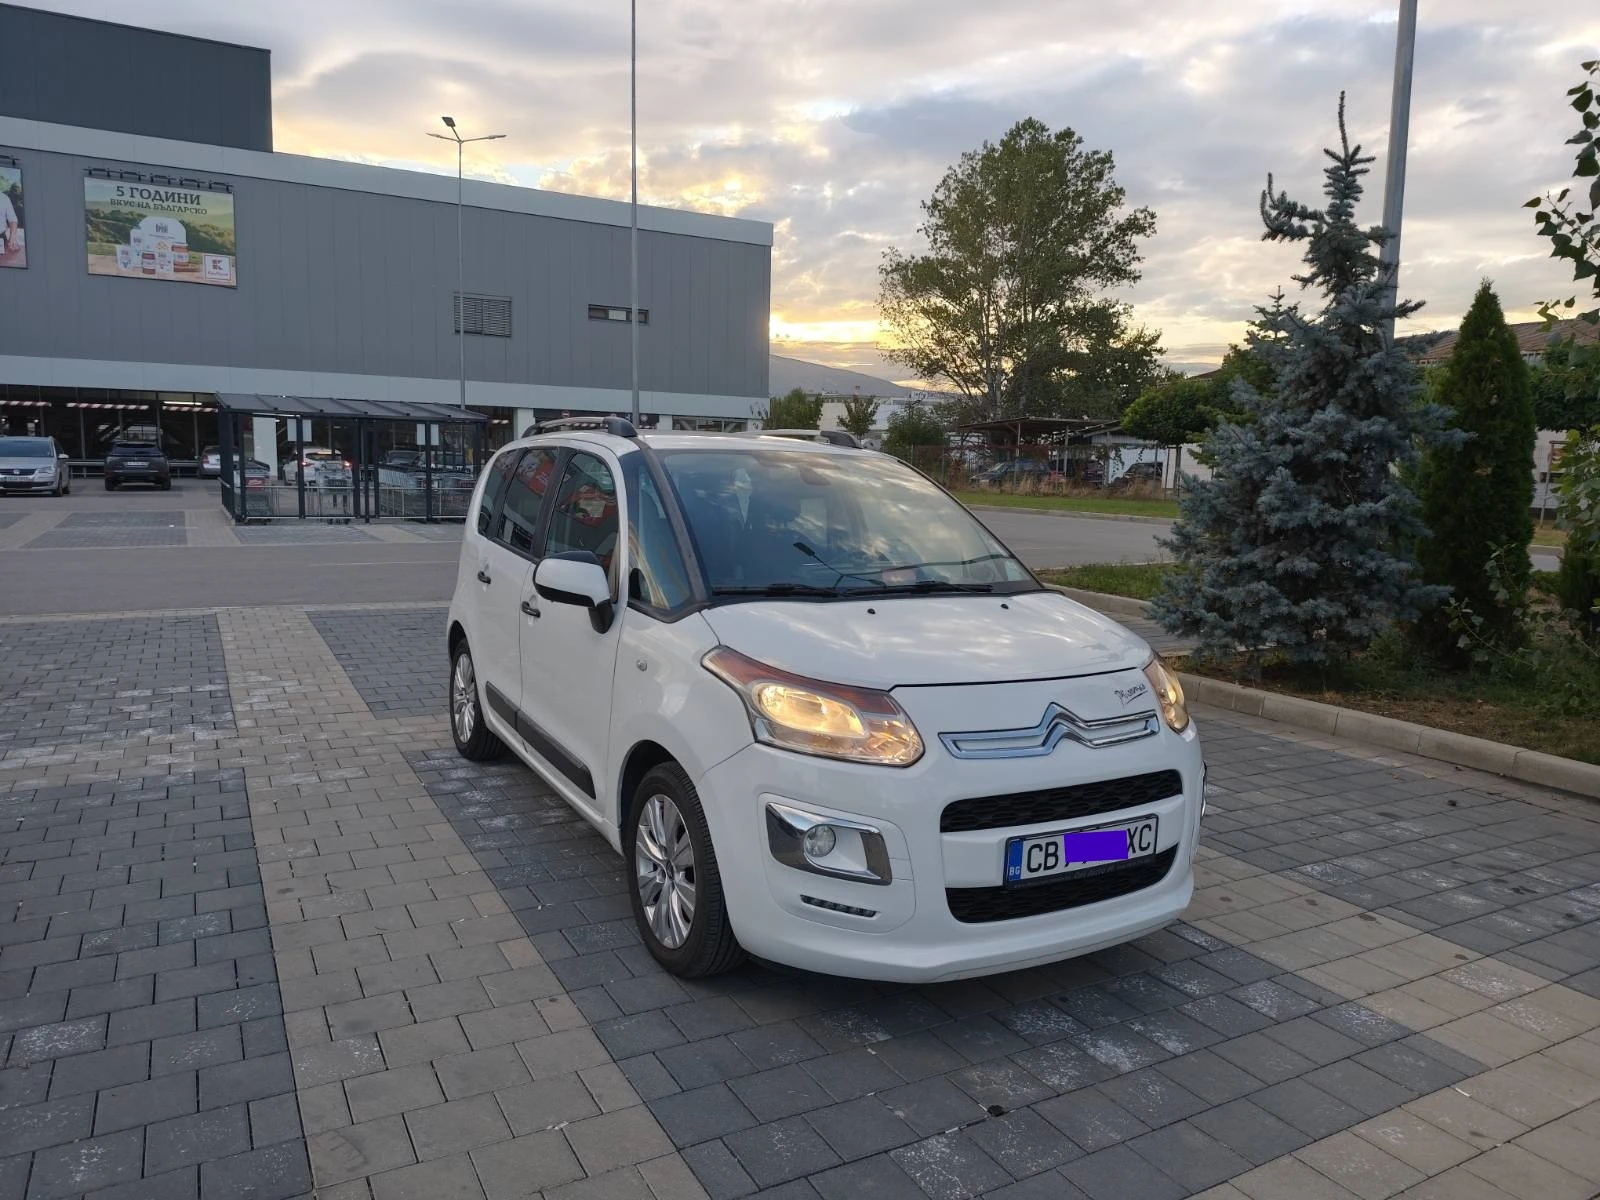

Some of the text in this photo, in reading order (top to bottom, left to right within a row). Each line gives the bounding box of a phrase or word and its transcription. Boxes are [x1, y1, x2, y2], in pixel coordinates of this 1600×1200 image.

[115, 185, 201, 206] 5 ГОДИНИ
[110, 198, 208, 215] ВКУС НА БЪЛГАРСКО
[1009, 865, 1021, 876] BG
